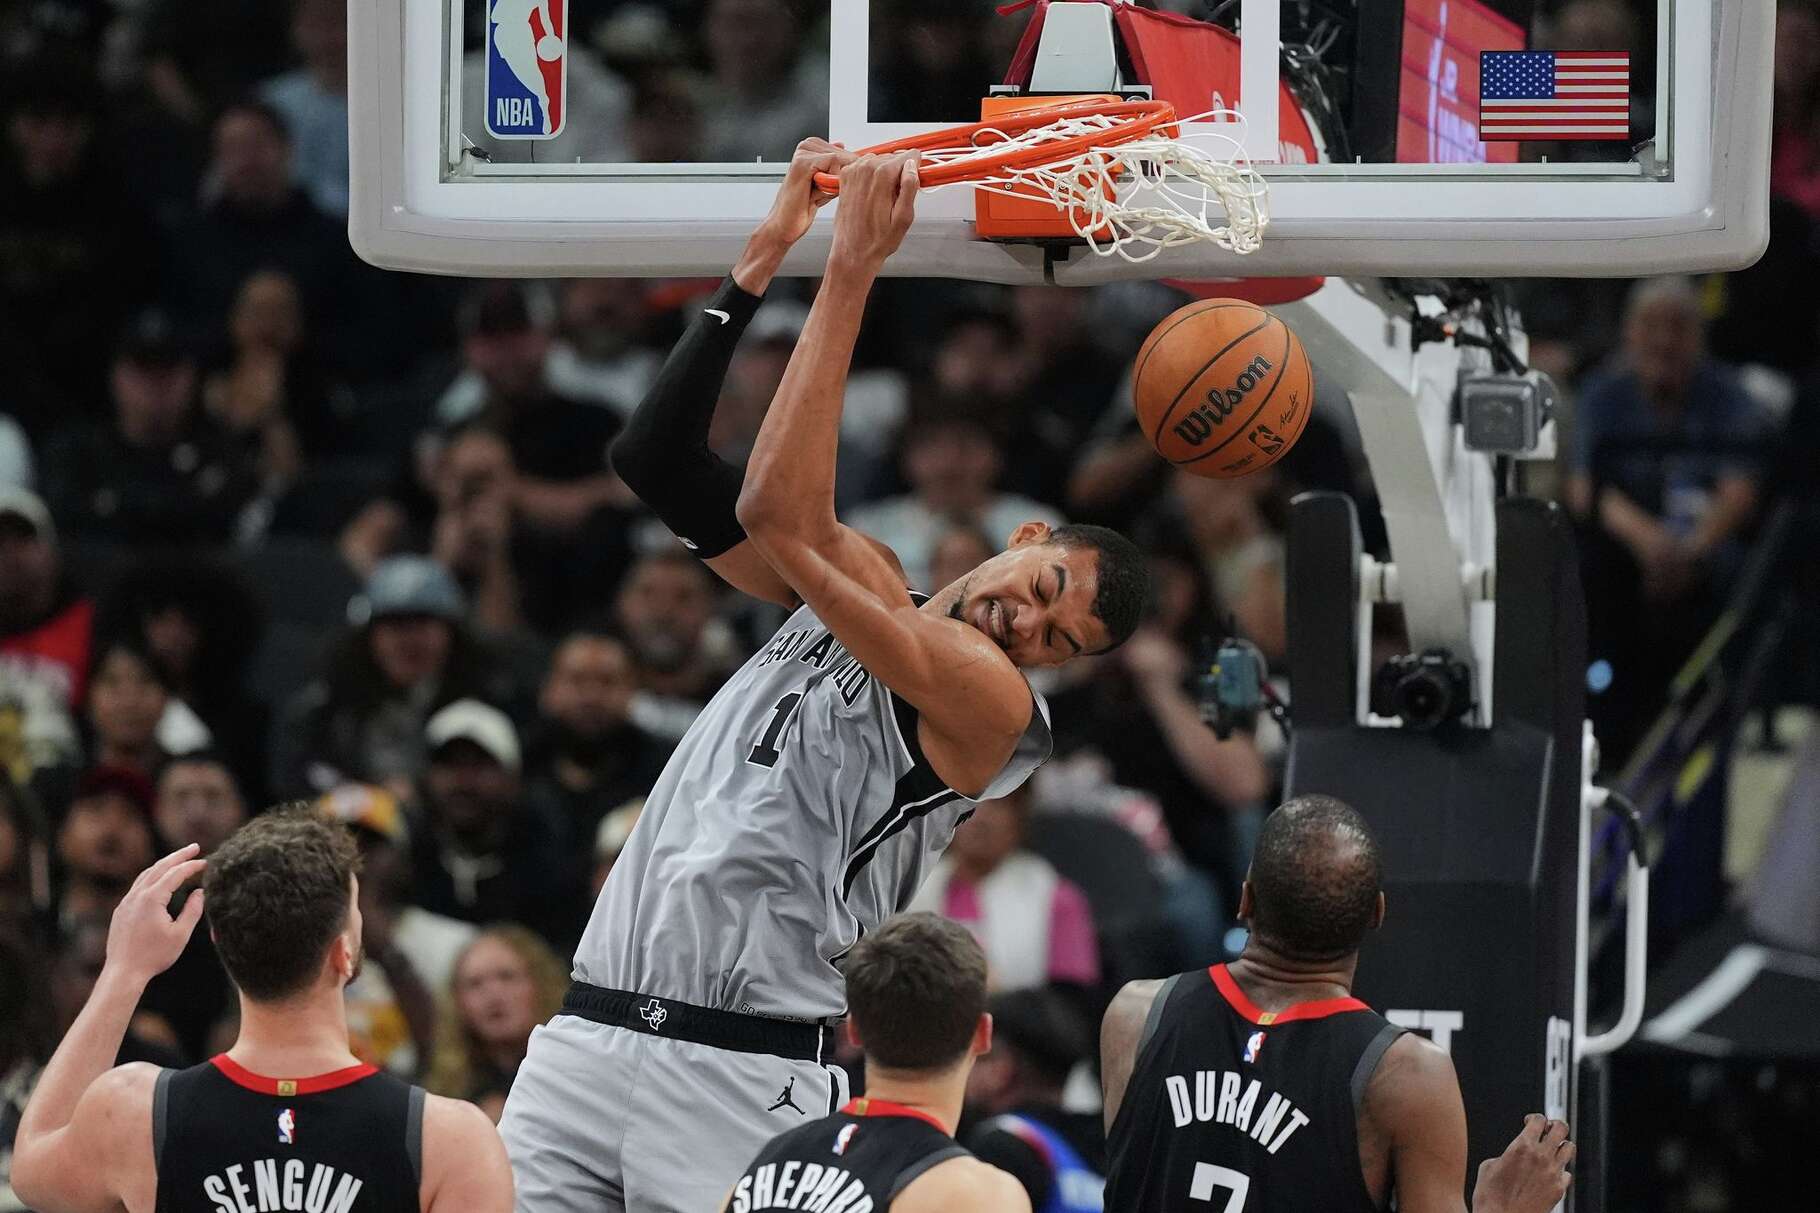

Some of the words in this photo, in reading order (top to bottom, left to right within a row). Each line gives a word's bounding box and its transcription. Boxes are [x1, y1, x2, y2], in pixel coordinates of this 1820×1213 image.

[496, 97, 534, 127] NBA
[1173, 353, 1272, 446] Wilson
[746, 691, 803, 768] 1
[1165, 1070, 1311, 1155] DURANT
[203, 1158, 364, 1213] SENGUN
